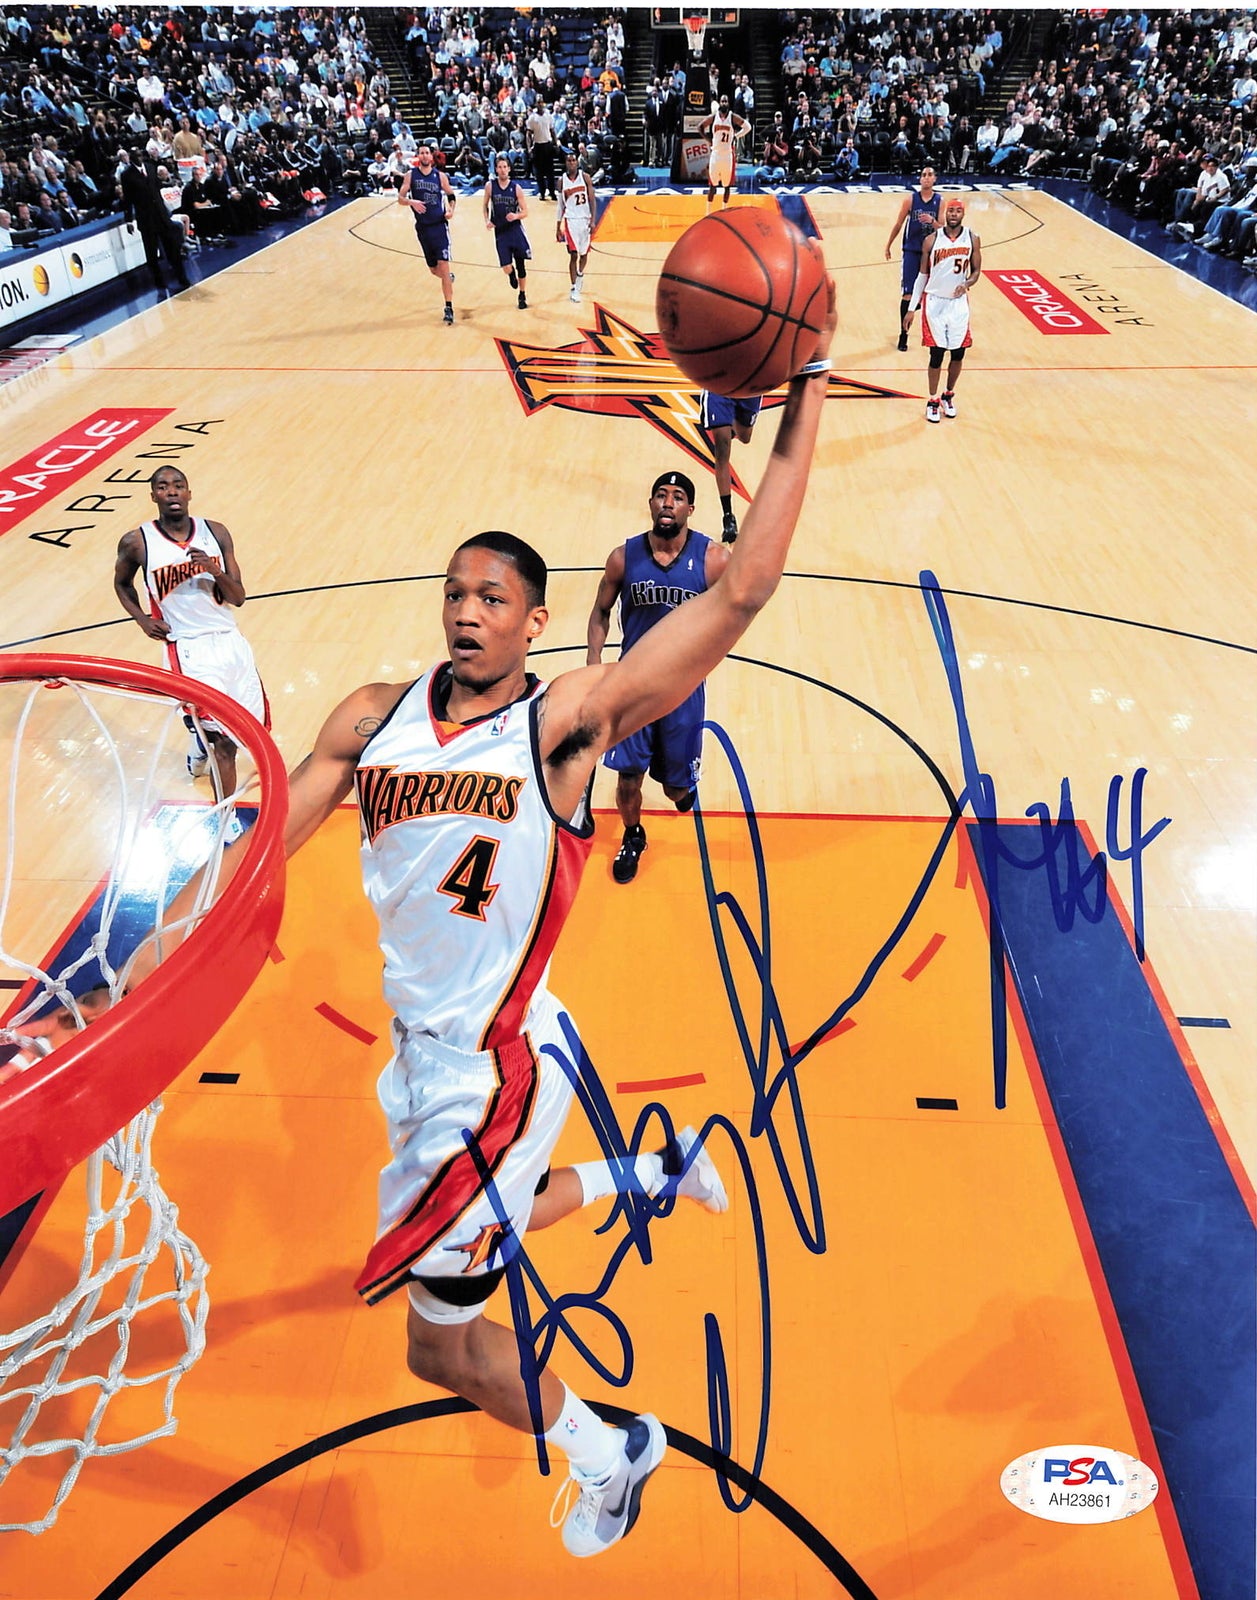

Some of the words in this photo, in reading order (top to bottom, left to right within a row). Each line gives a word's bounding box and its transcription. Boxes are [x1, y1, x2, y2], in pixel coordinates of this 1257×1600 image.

[685, 143, 709, 159] FRS
[721, 132, 729, 143] 21
[575, 193, 586, 205] 23
[934, 247, 970, 267] WARRIORS
[999, 273, 1084, 328] ORACLE
[1058, 273, 1155, 327] ARENA
[28, 419, 225, 549] ARENA
[355, 765, 527, 843] WARRIORS
[436, 834, 501, 922] 4
[1043, 1457, 1119, 1486] PSA
[1048, 1492, 1110, 1508] AH23861
